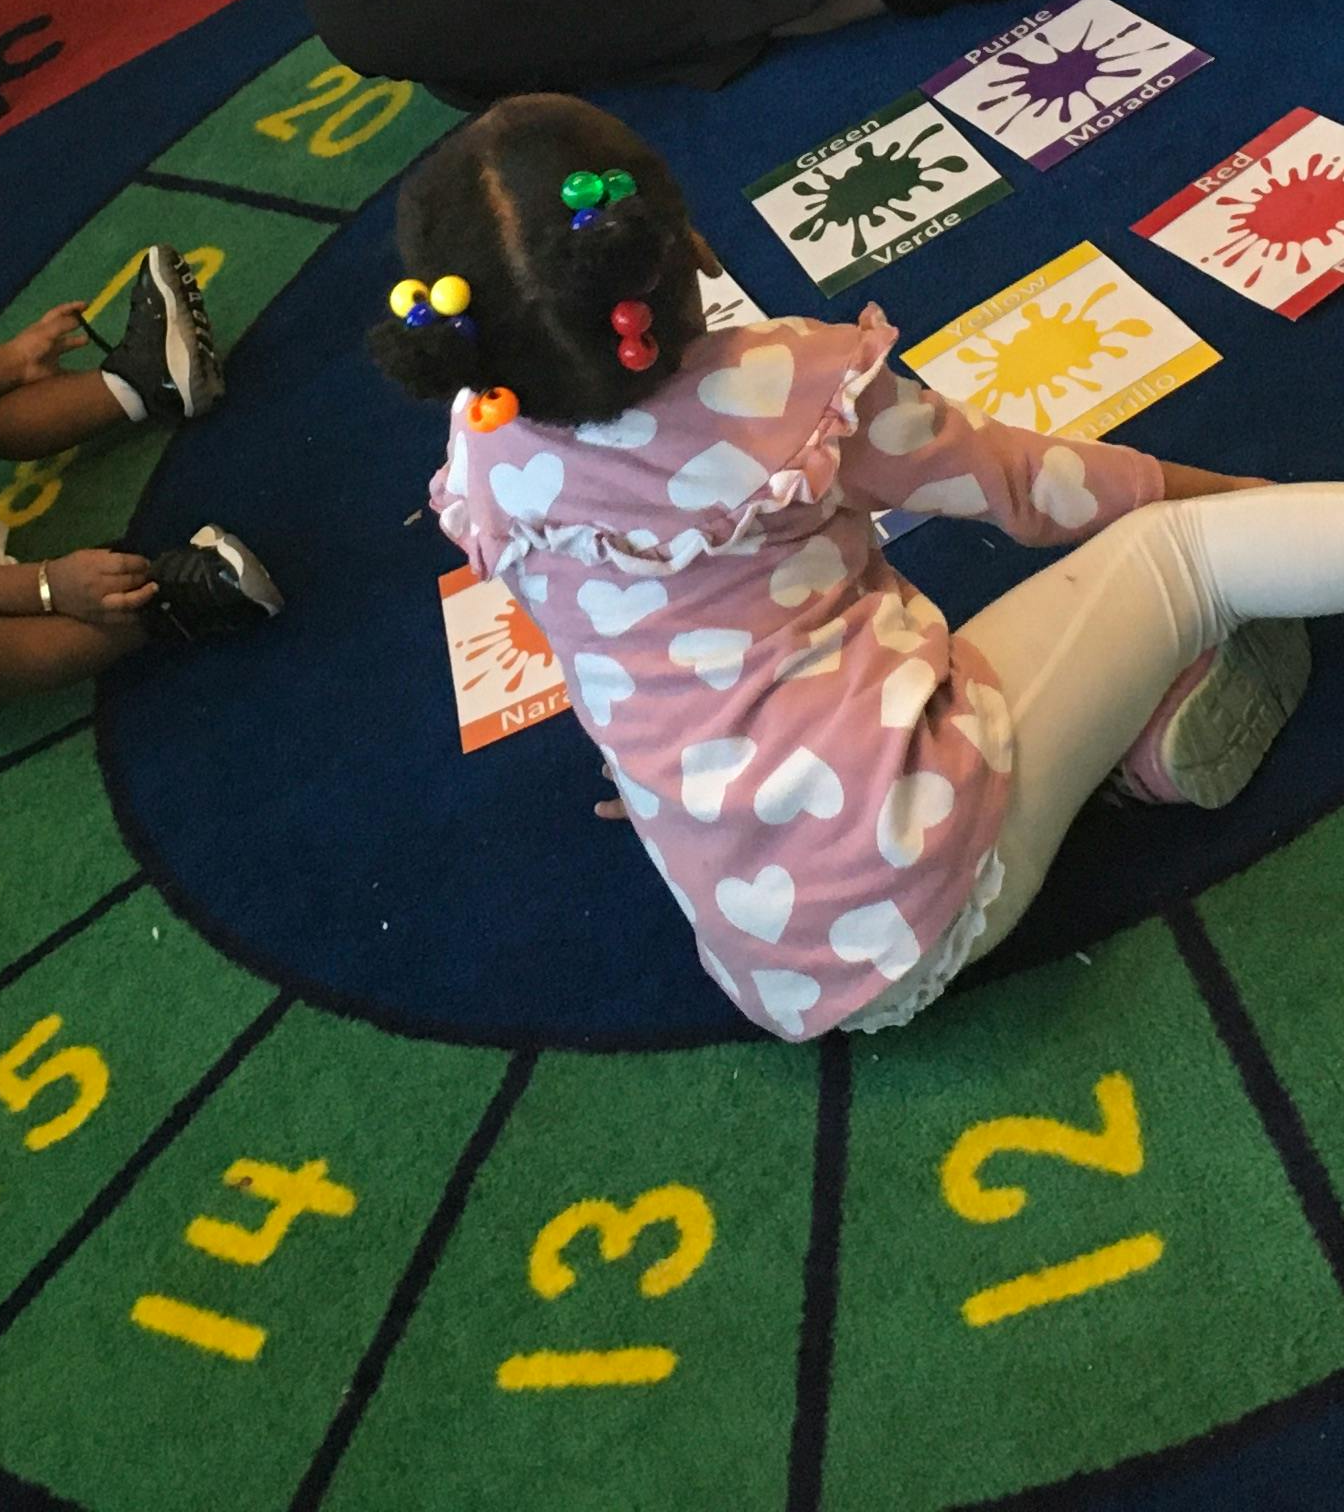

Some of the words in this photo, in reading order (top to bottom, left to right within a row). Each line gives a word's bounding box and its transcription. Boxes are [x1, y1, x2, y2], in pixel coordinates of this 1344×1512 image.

[964, 3, 1056, 68] Purple
[255, 65, 415, 158] 20
[795, 118, 884, 172] Green
[1066, 71, 1180, 149] Morado
[1194, 148, 1257, 197] Red
[871, 208, 964, 267] Verde
[946, 274, 1052, 341] Yellow
[1061, 370, 1176, 440] marillo
[941, 1071, 1166, 1329] 12
[130, 1158, 359, 1361] 14
[496, 1183, 717, 1392] 13
